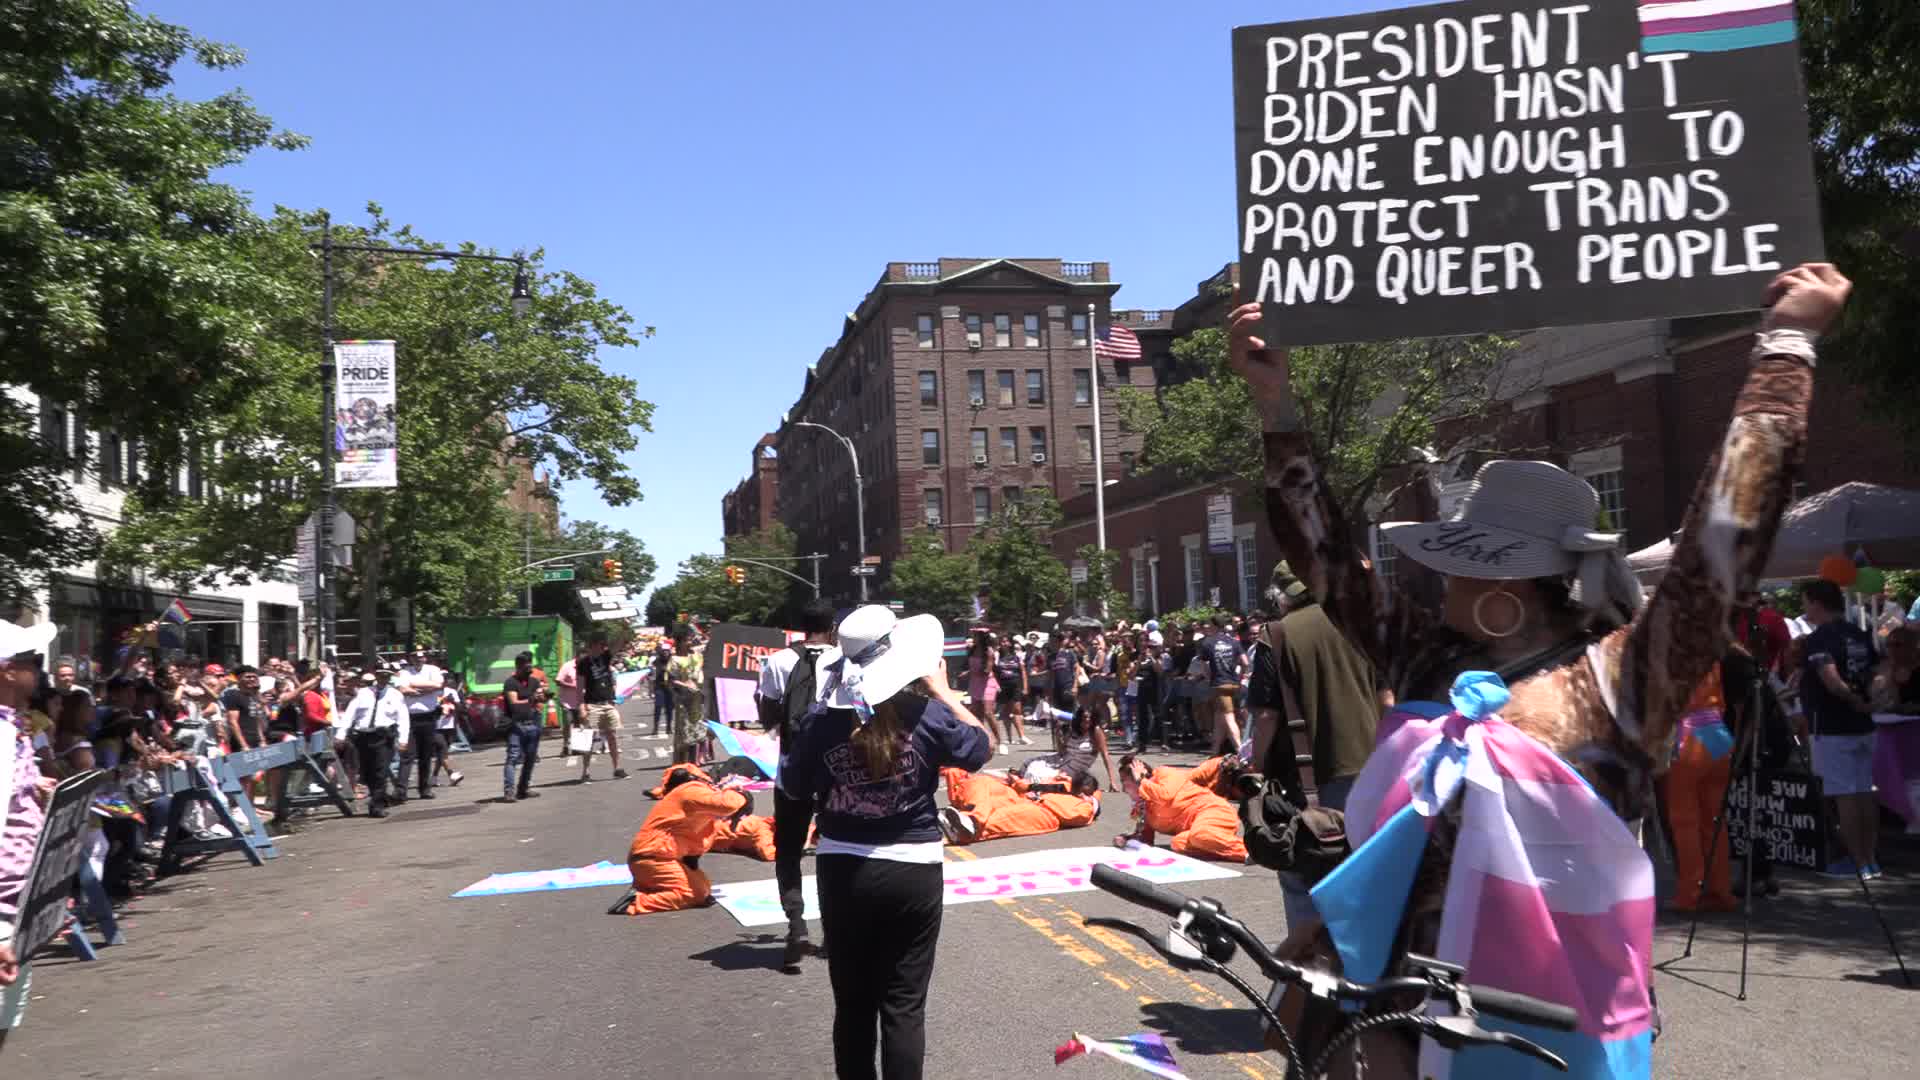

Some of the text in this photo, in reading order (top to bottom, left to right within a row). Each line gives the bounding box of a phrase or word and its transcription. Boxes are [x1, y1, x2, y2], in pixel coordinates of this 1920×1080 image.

[1265, 5, 1591, 94] PRESIDENT
[1263, 51, 1691, 146] BIDEN HASN'T
[1249, 110, 1745, 196] DONE ENOUGH TO
[1243, 169, 1730, 254] PROTECT TRANS
[1256, 223, 1782, 305] AND QUEER PEOPLE
[341, 367, 390, 380] PRIDE
[722, 642, 782, 672] PRID
